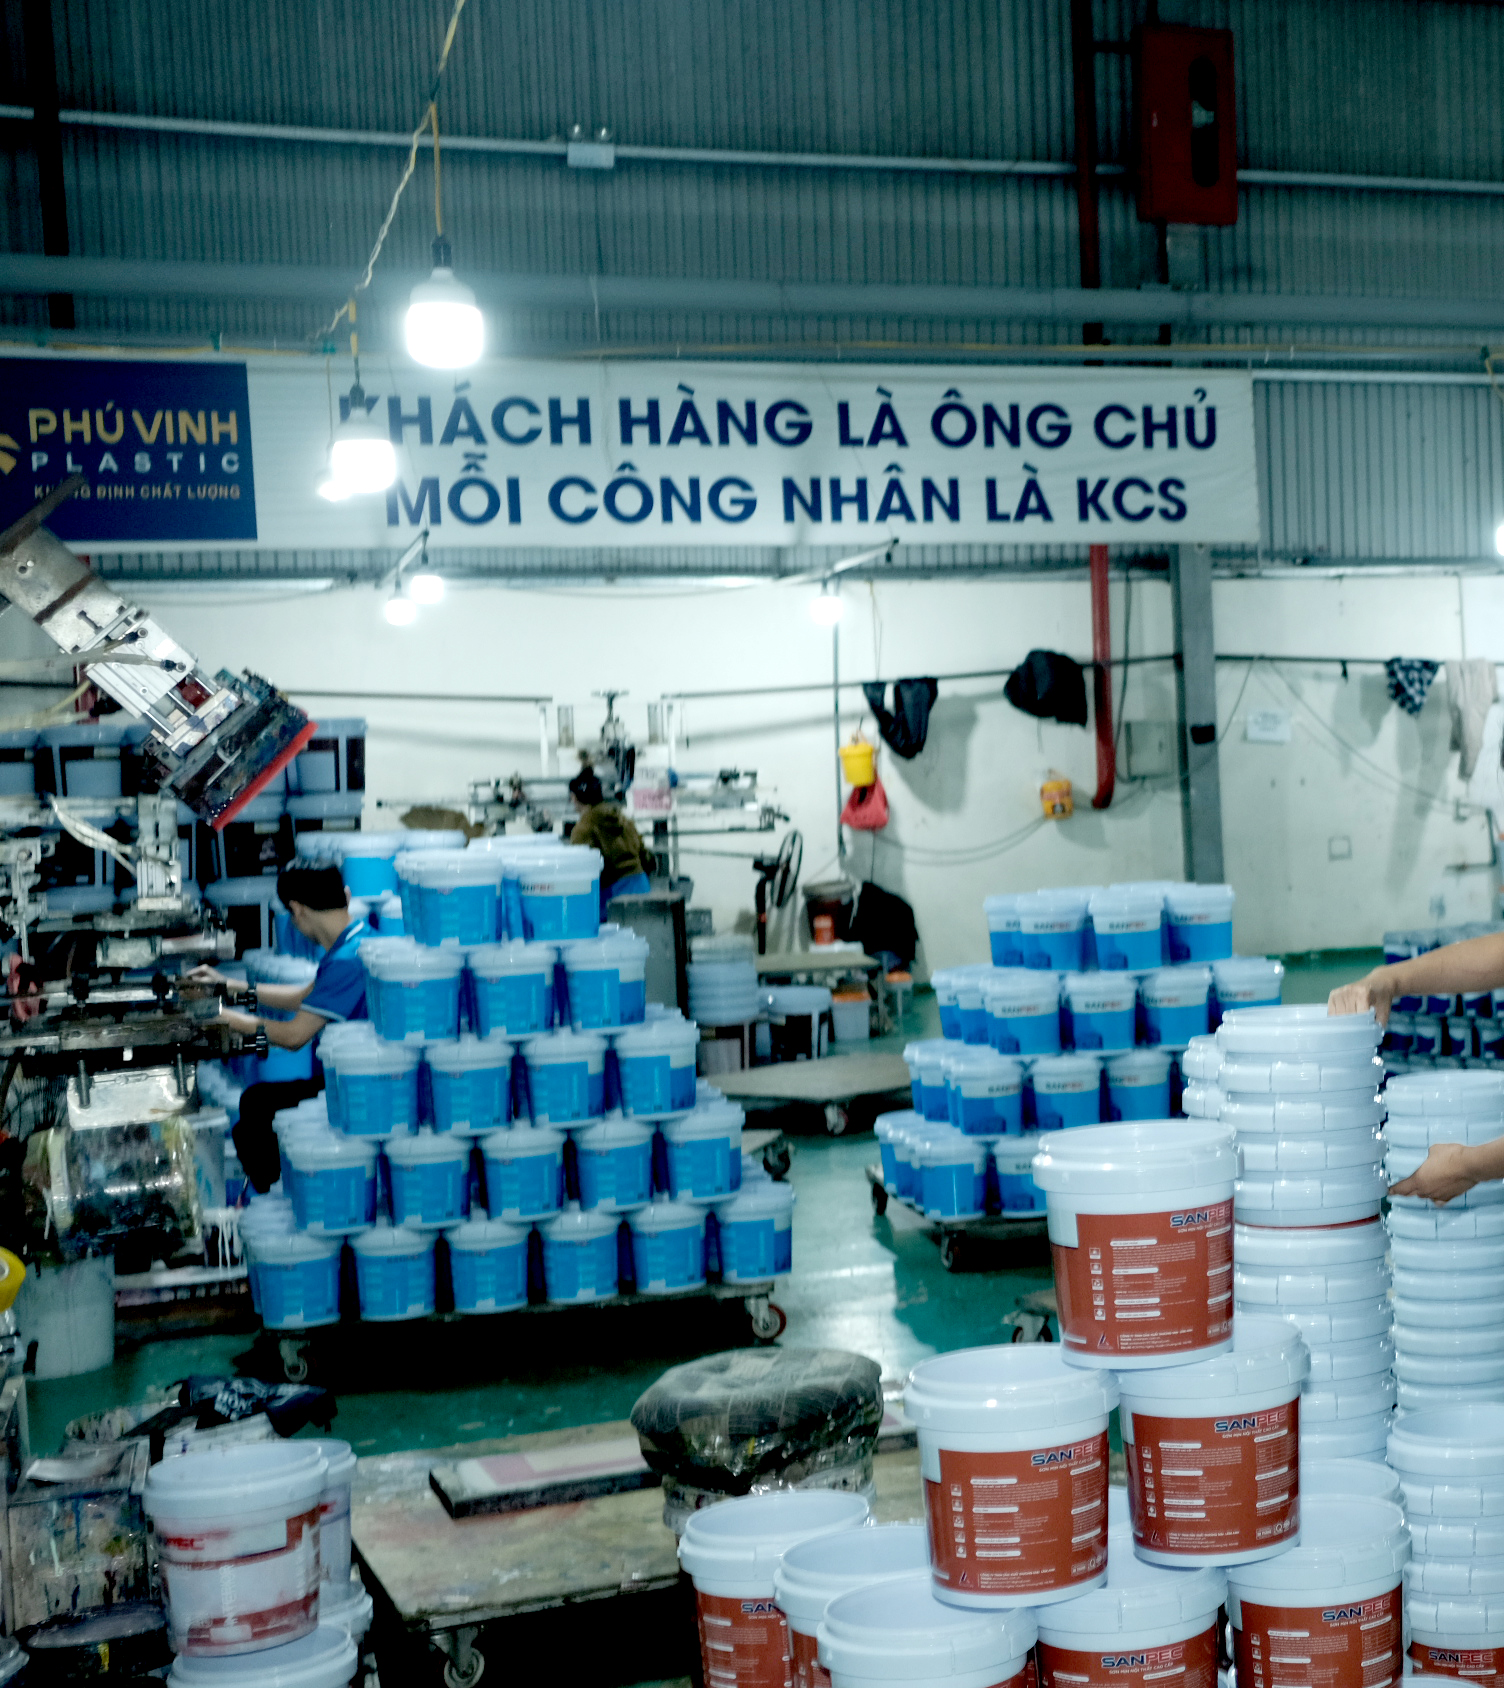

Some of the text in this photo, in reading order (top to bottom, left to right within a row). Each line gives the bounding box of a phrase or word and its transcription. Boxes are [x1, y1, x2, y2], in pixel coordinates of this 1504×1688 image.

[619, 382, 813, 447] HÀNG
[837, 384, 910, 448] LÀ
[931, 387, 1072, 449] ÔNG
[1094, 388, 1218, 450] CHỦ
[31, 451, 240, 475] PLASTIC
[386, 452, 1189, 527] MỖI CÔNG NHÂN LÀ KCS
[1213, 1409, 1287, 1433] SANPEC
[1030, 1442, 1101, 1466] SANPEC
[1321, 1597, 1391, 1622] SANPEC
[1101, 1646, 1183, 1668] SANPEC
[1428, 1650, 1493, 1664] SANPEC
